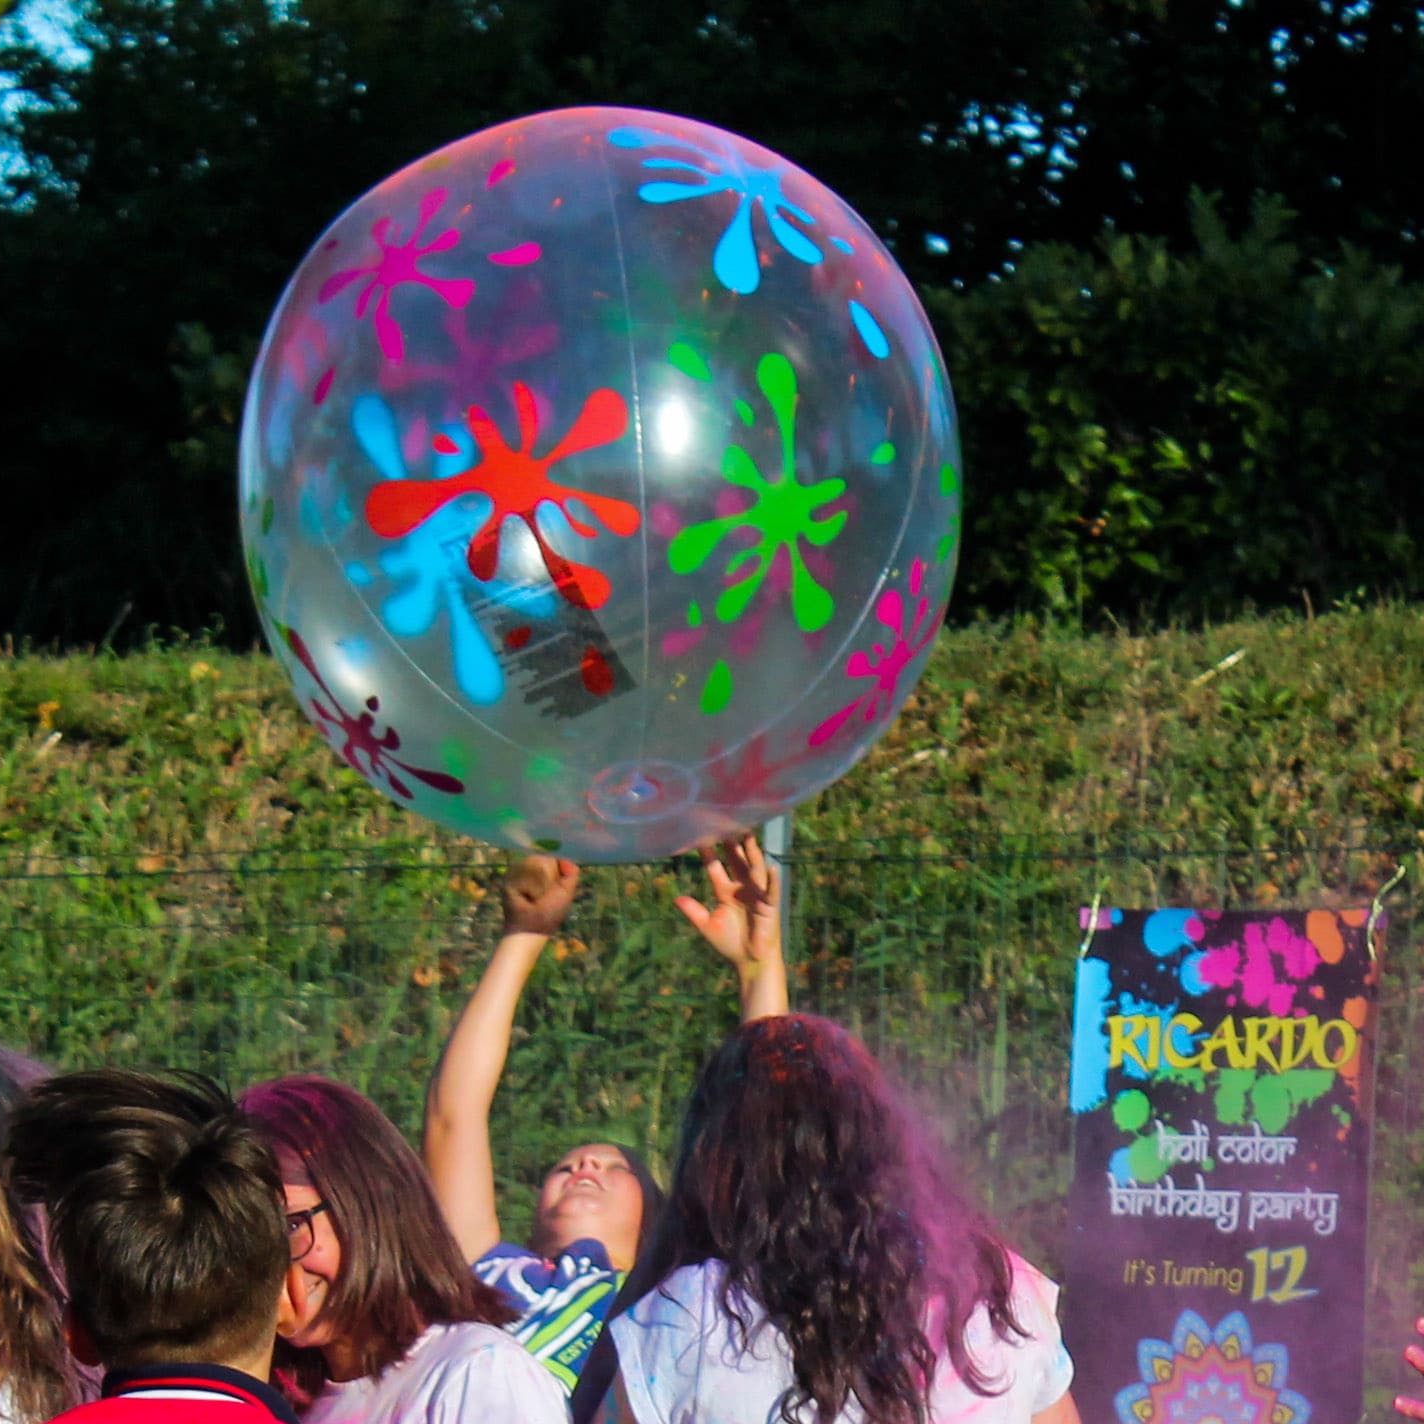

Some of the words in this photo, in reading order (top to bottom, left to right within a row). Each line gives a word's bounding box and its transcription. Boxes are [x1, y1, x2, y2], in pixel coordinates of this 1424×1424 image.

[1107, 1012, 1358, 1075] RICARDO
[1155, 1119, 1210, 1163] holi
[1217, 1120, 1298, 1165] color
[1106, 1171, 1242, 1234] birthday
[1248, 1186, 1339, 1236] party
[1123, 1259, 1157, 1287] It's
[1162, 1259, 1245, 1295] Turning
[1245, 1245, 1321, 1303] 12
